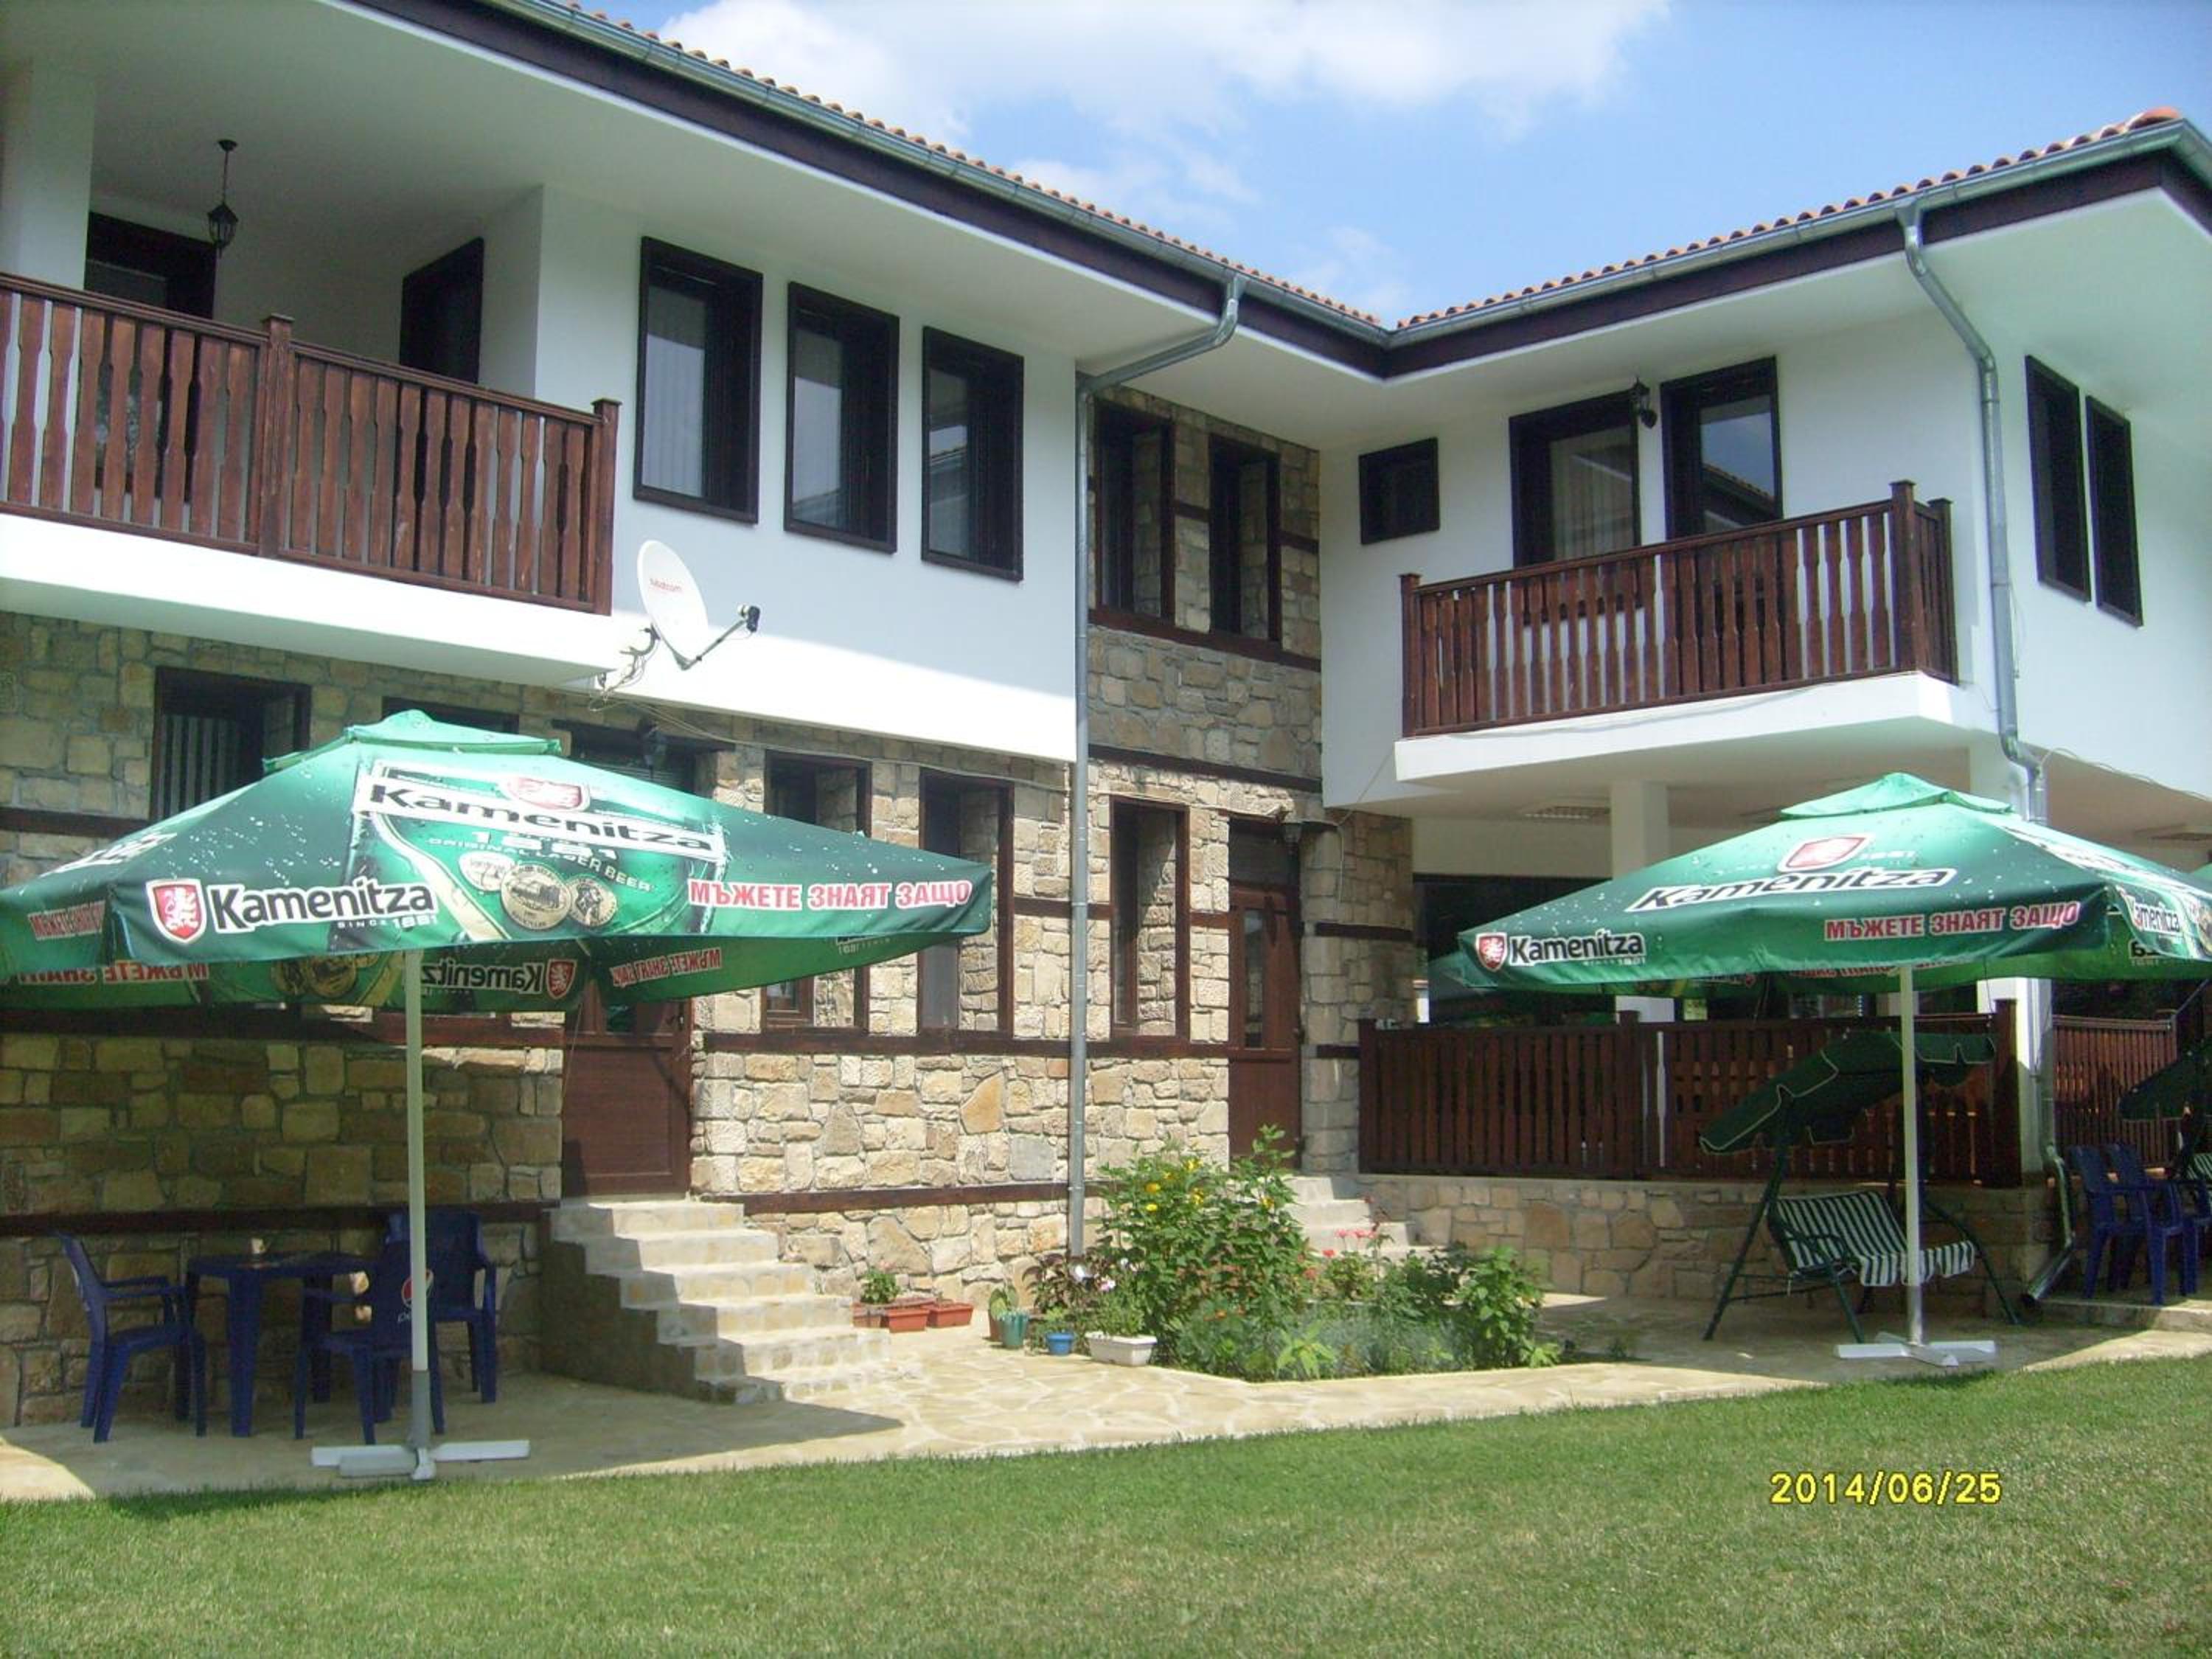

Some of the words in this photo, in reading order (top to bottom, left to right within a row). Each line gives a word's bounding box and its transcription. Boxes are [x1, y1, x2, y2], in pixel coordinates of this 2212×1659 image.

[369, 783, 714, 851] Kamenitza
[604, 864, 651, 892] BEER
[689, 880, 801, 909] МЪЖЕТЕ
[809, 882, 891, 908] ЗНАЯТ
[896, 880, 972, 908] ЗАЩО
[1636, 869, 1950, 909] Kamenitza
[209, 878, 435, 930] Kamenitza
[1826, 915, 1924, 939] МЪЖЕТЕ
[1930, 908, 2006, 933] ЗНАЯТ
[2011, 902, 2080, 928] ЗАЩО
[1511, 929, 1644, 964] Kamenitza
